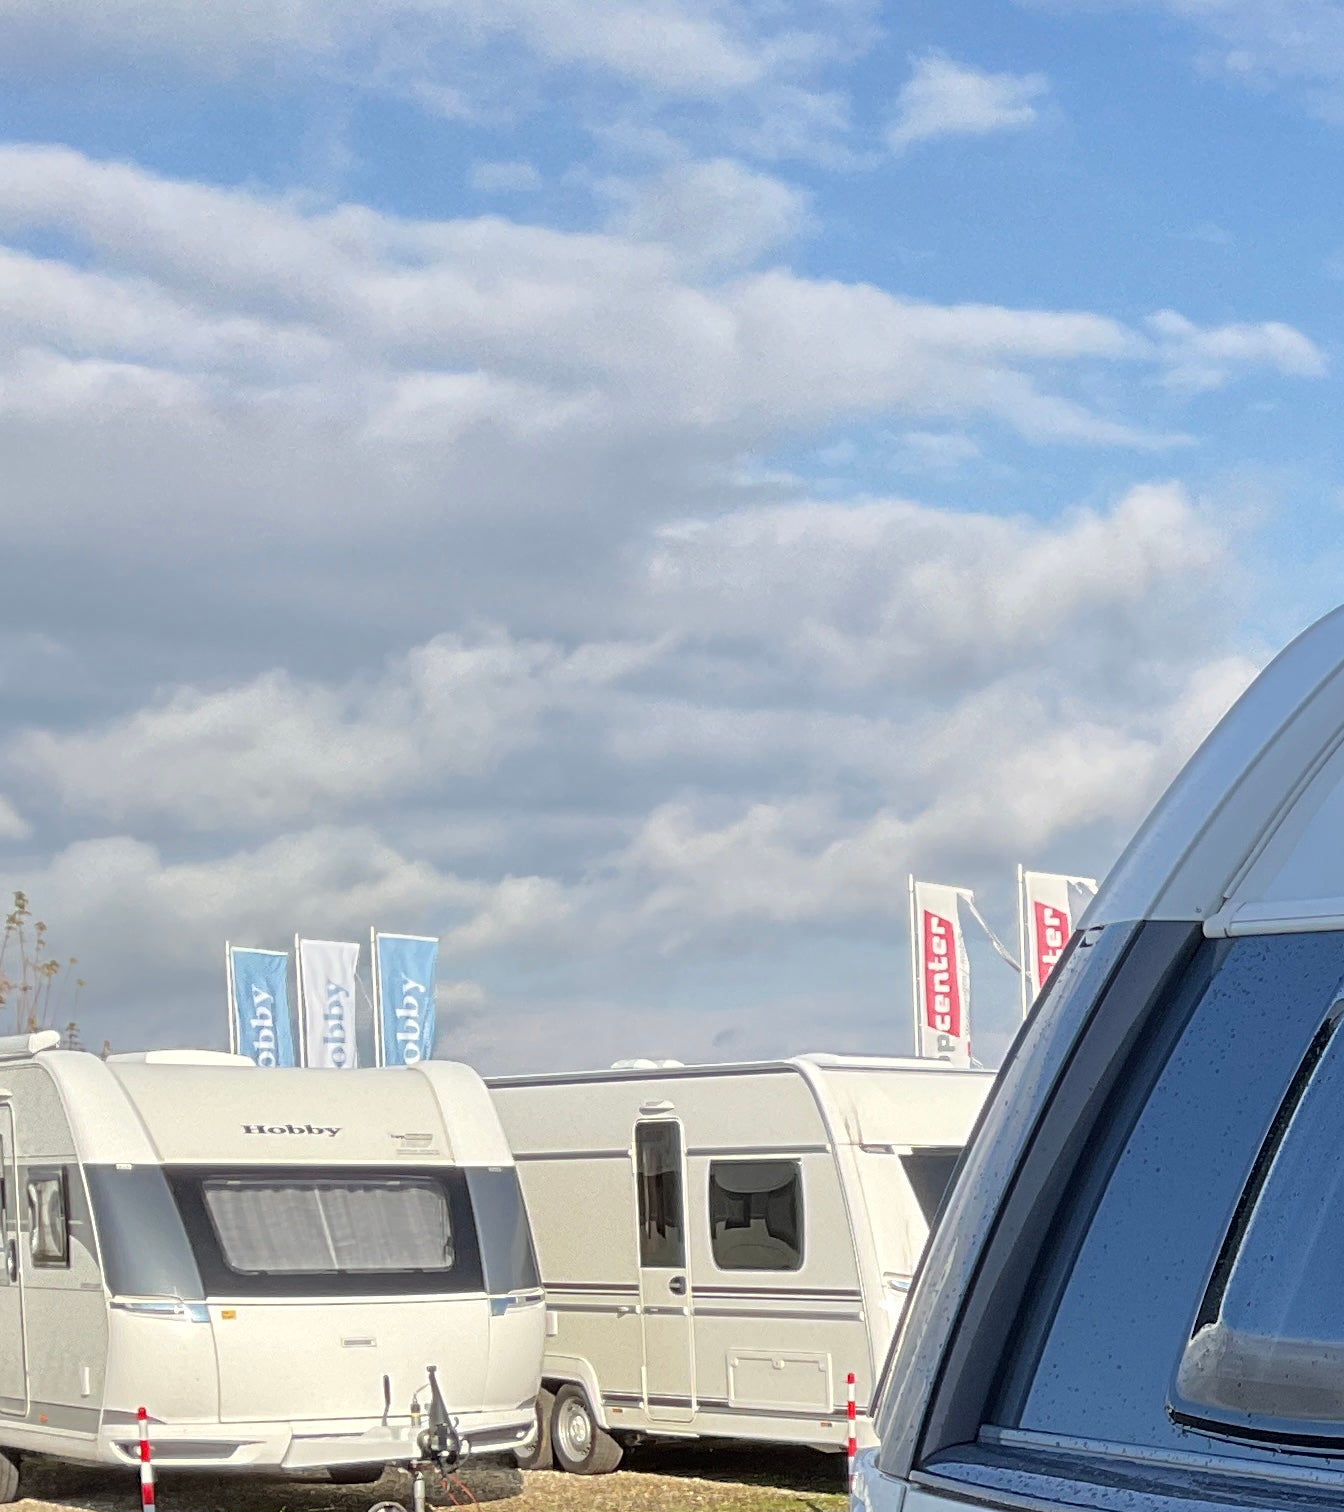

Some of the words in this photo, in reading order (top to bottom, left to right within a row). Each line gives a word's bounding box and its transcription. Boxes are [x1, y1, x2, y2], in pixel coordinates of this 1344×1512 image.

[251, 983, 277, 1068] obby
[323, 979, 350, 1068] obby
[396, 972, 426, 1065] obby
[928, 916, 955, 1061] pcenter
[242, 1124, 343, 1138] Hobby
